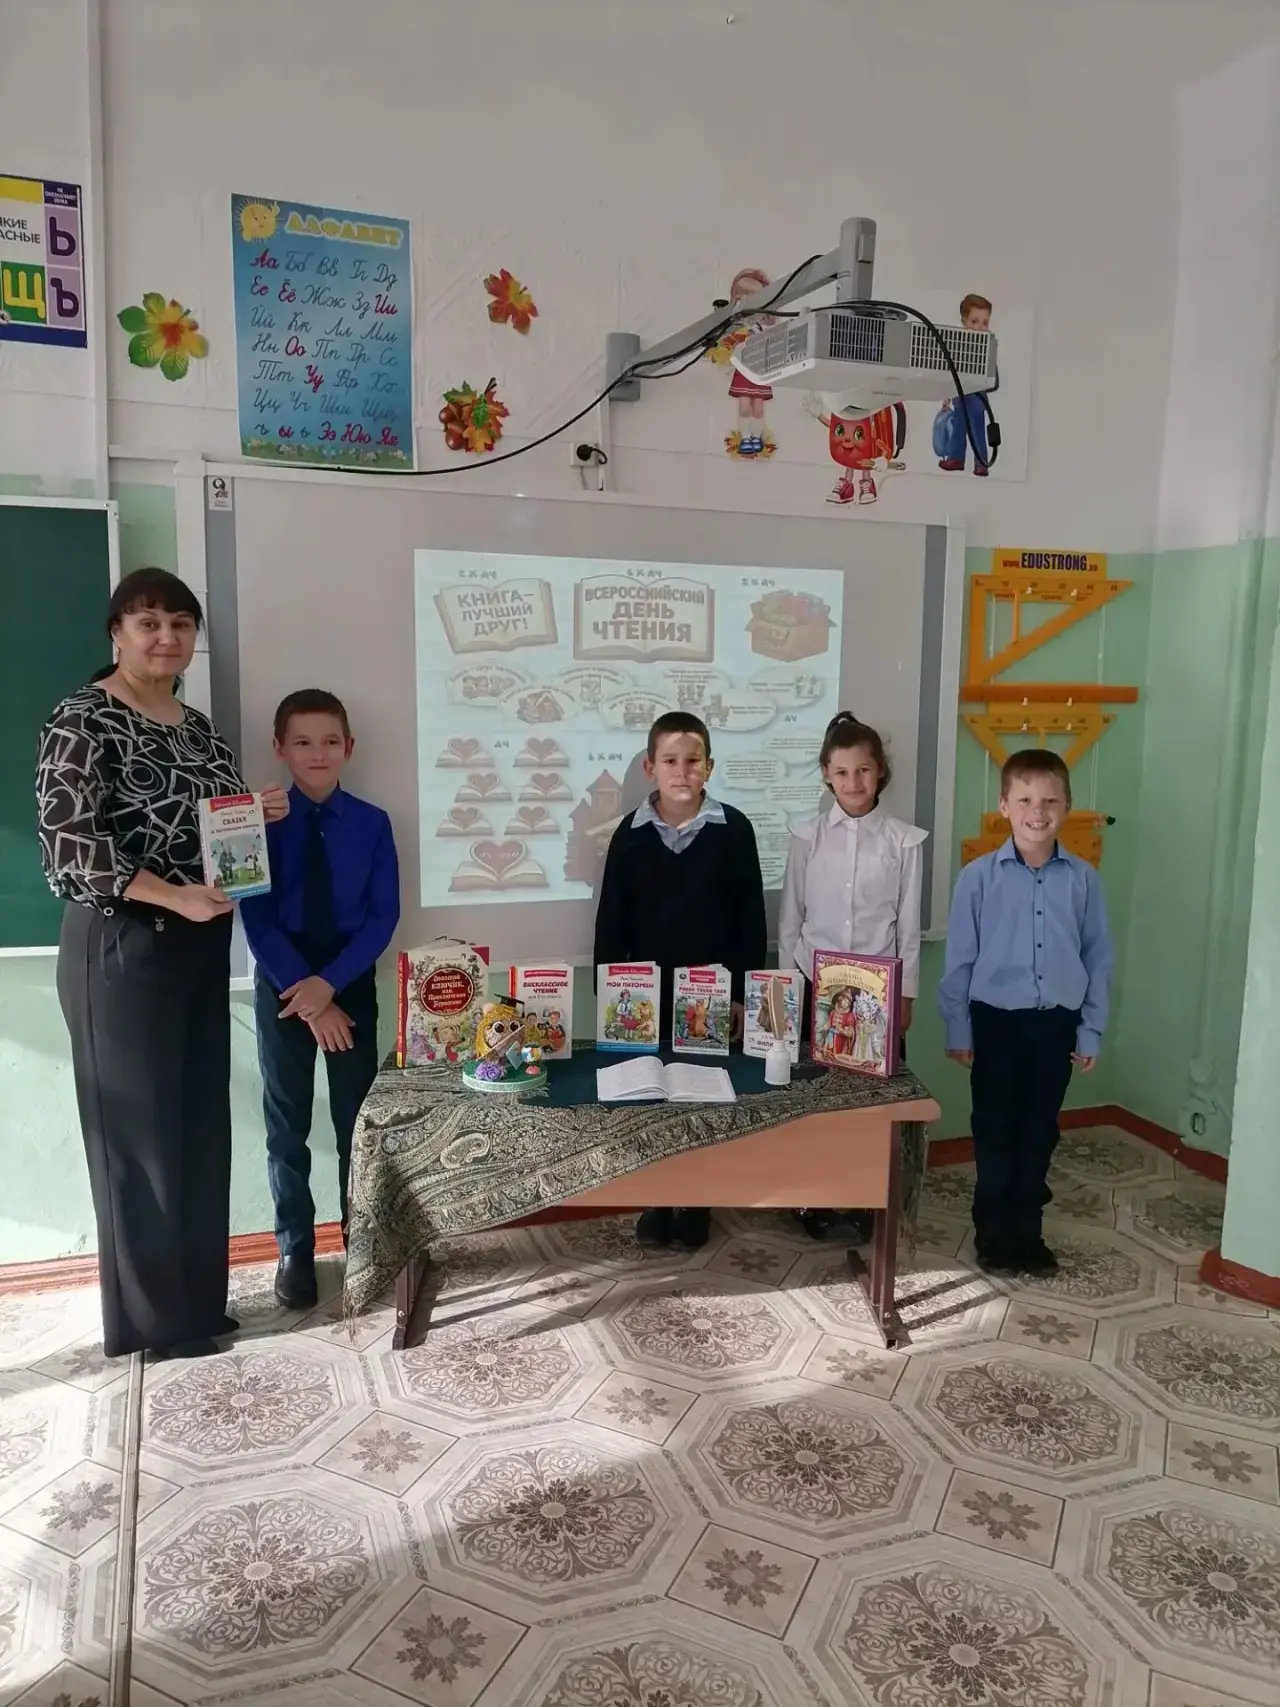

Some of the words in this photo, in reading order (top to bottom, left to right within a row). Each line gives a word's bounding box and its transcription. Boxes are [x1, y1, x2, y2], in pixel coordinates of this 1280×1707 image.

[0, 216, 28, 230] КИЕ
[3, 268, 46, 319] Щ
[585, 585, 705, 605] ВСЕРОССИЙСКИЙ
[461, 602, 534, 622] ЛУЧШИЙ
[612, 601, 675, 620] ДЕНЬ
[474, 617, 528, 638] ДРУГ!
[592, 620, 692, 643] ЧТЕНИЯ
